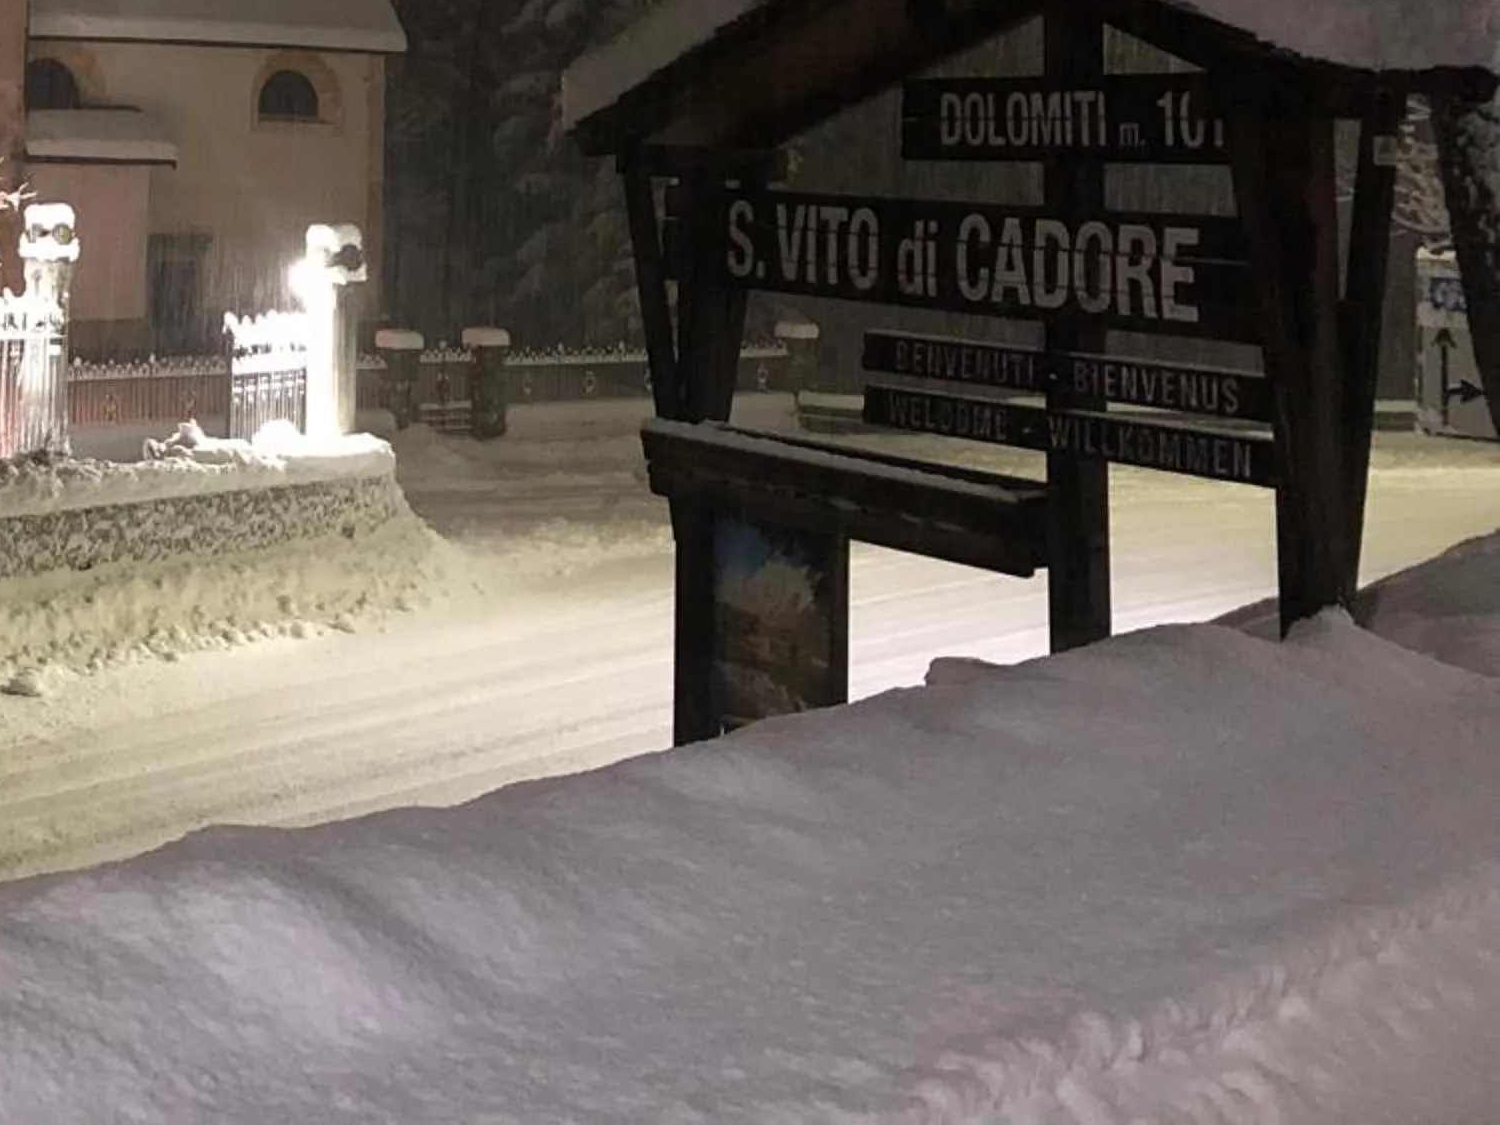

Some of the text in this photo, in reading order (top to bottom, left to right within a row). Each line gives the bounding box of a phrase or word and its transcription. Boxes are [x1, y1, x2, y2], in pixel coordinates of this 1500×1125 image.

[940, 90, 1106, 148] DOLOMITI
[727, 199, 1199, 323] S. VITO di CADORE
[896, 340, 1239, 413] BENVENUTI BIENVENUS
[1050, 414, 1251, 477] WILLKOMMEN
